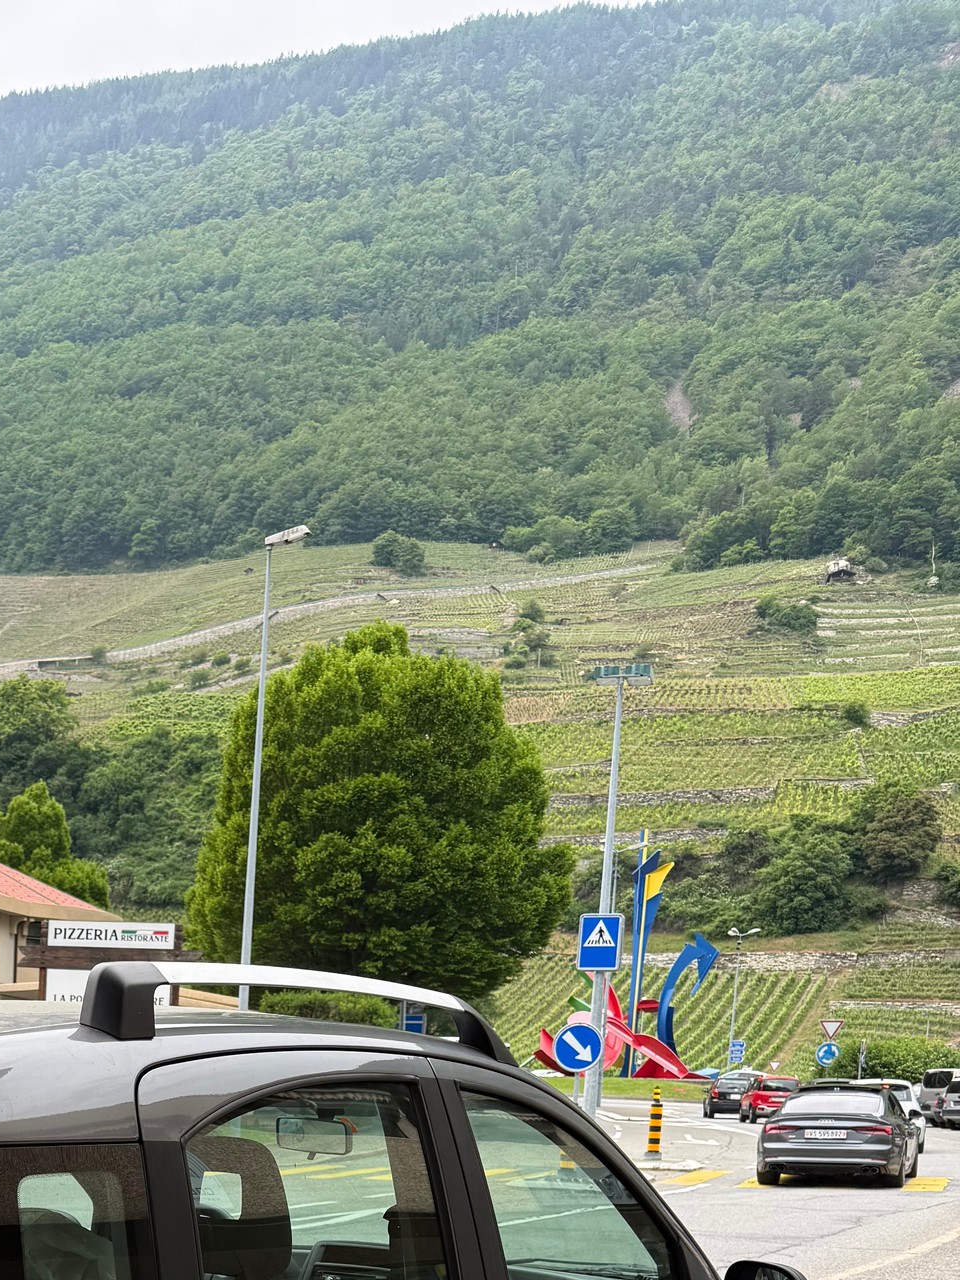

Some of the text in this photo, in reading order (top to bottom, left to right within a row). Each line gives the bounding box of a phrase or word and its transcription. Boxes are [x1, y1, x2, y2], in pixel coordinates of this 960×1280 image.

[53, 927, 170, 943] PIZZERIA RISTORANTE
[69, 994, 83, 1003] PO
[153, 997, 166, 1007] RE
